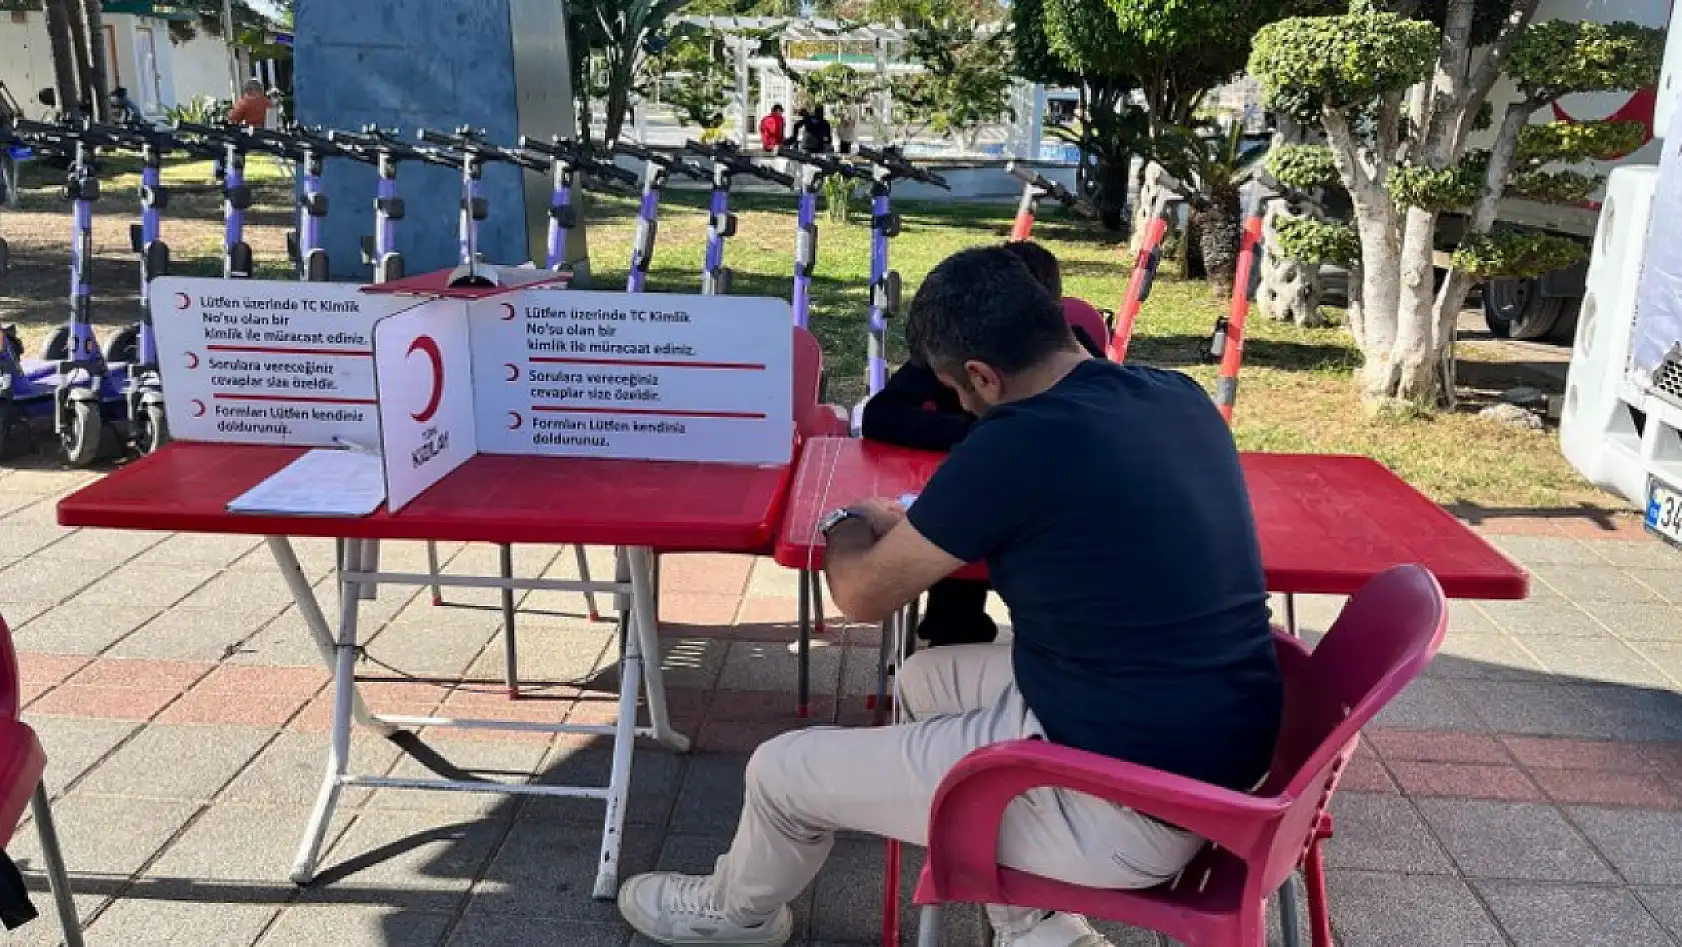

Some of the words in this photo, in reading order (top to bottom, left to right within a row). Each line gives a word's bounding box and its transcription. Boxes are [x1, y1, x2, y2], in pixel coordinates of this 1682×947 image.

[200, 297, 239, 309] Lütfen
[243, 298, 298, 310] üzerinde
[300, 301, 317, 312] TC
[320, 301, 359, 313] Kimlik
[203, 313, 238, 324] No'su
[241, 314, 269, 325] olan
[271, 315, 289, 326] bir
[526, 307, 566, 319] Lütfen
[570, 308, 626, 320] üzerinde
[630, 310, 646, 322] TC
[649, 310, 691, 322] Kimlik
[205, 327, 242, 340] kimlik
[245, 330, 261, 342] ile
[264, 332, 323, 343] müracaat
[326, 332, 368, 344] ediniz.
[527, 324, 563, 336] No'su
[566, 326, 594, 336] olan
[598, 325, 616, 337] bir
[528, 340, 566, 352] kimlik
[570, 341, 586, 352] ile
[590, 343, 651, 354] müracaat
[654, 344, 696, 356] ediniz.
[209, 358, 261, 371] Sorulara
[264, 360, 334, 375] vereceğiniz
[211, 375, 263, 389] cevaplar
[267, 377, 289, 388] size
[293, 376, 336, 390] özeldir.
[529, 370, 583, 382] Sorulara
[586, 373, 658, 386] vereceğiniz
[531, 388, 584, 400] cevaplar
[588, 390, 612, 400] size
[615, 389, 660, 402] özeldir.
[215, 406, 267, 418] Formları
[270, 407, 308, 419] Lütfen
[311, 408, 364, 421] kendiniz
[217, 421, 292, 434] doldurunuz.
[532, 418, 586, 430] Formları
[590, 420, 630, 432] Lütfen
[633, 421, 686, 434] kendiniz
[533, 432, 610, 446] doldurunuz.
